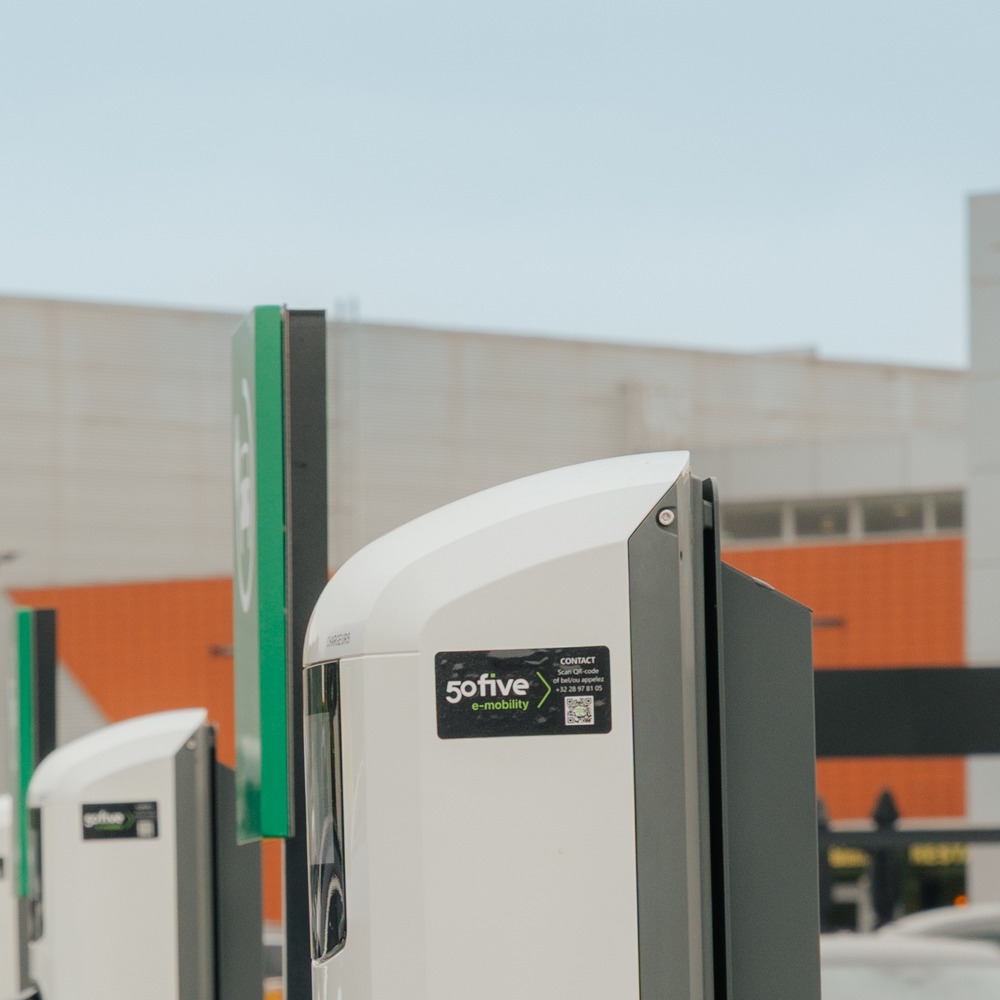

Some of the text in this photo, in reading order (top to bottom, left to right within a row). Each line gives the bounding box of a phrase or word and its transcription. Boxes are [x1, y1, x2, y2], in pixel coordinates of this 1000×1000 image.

[560, 656, 596, 665] CONTACT
[573, 667, 599, 675] QR-code
[581, 676, 604, 684] appelez
[471, 700, 529, 711] e-mobility
